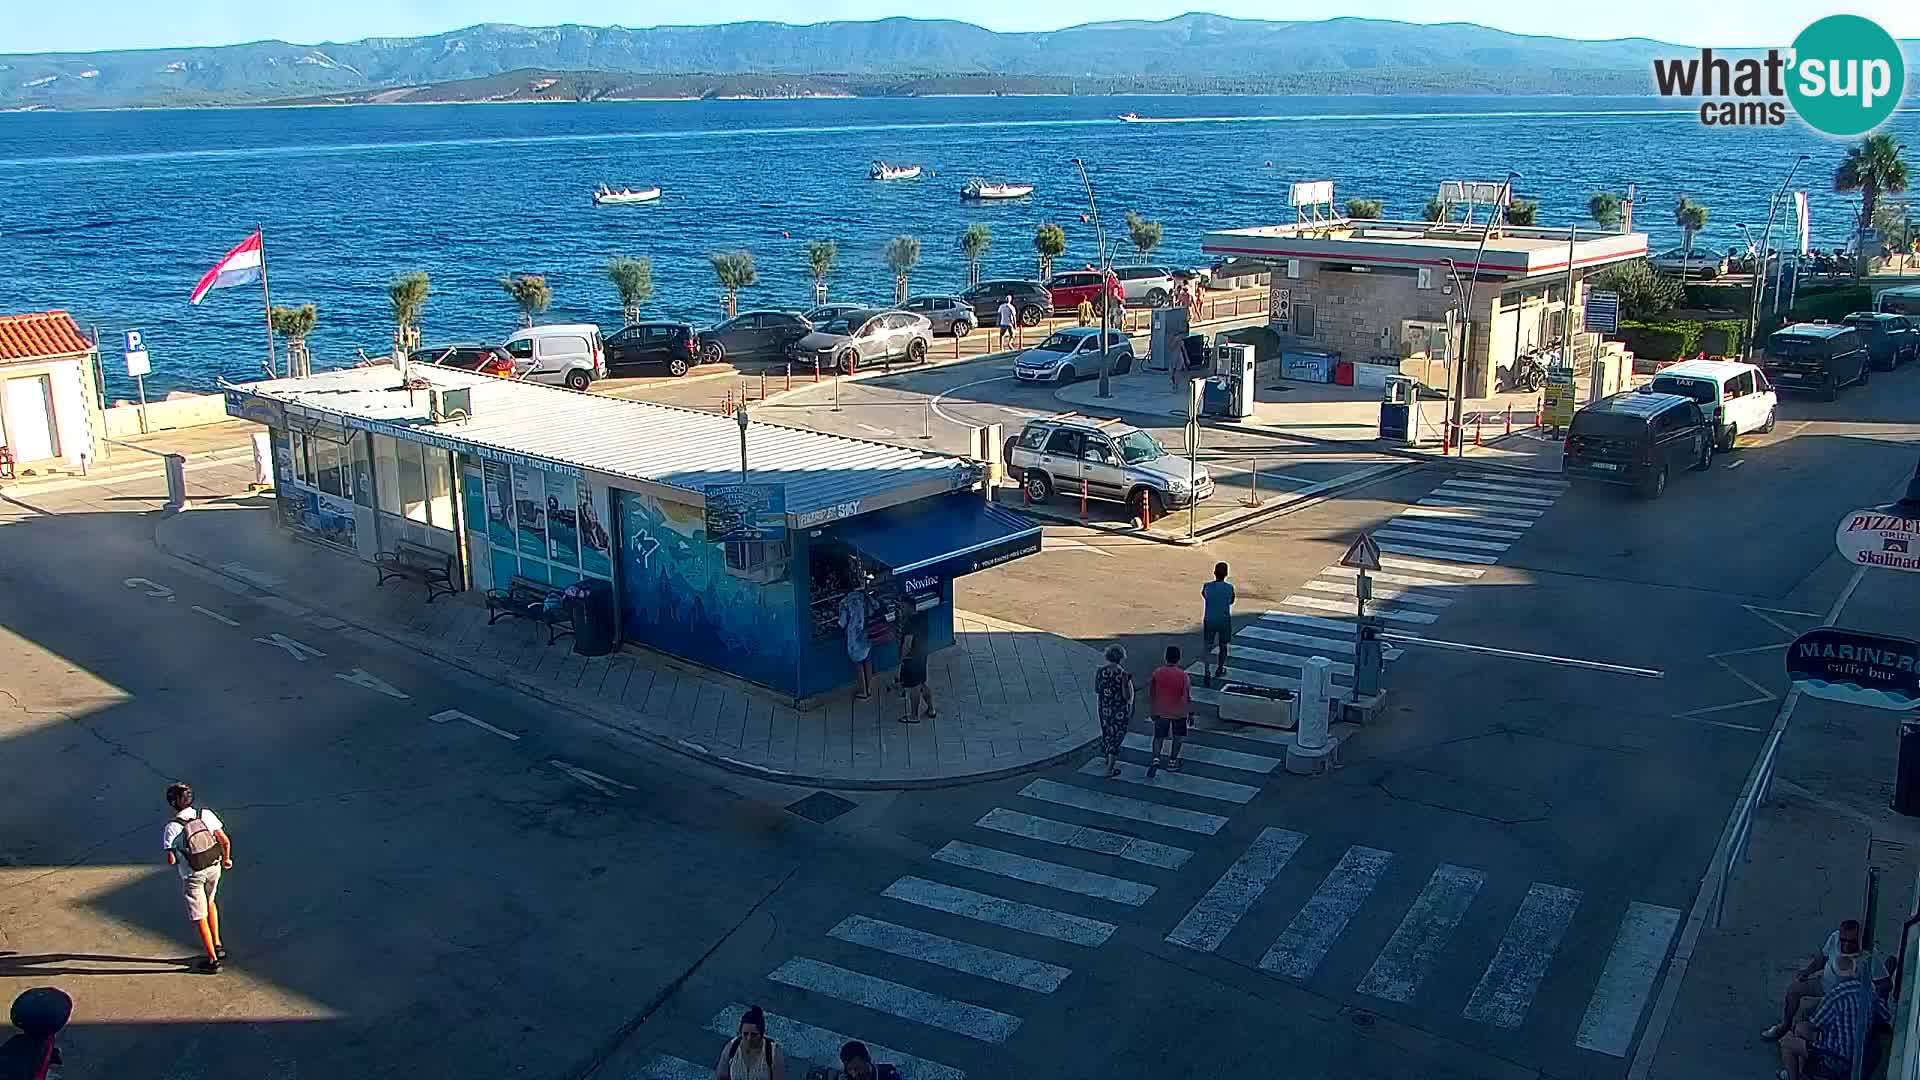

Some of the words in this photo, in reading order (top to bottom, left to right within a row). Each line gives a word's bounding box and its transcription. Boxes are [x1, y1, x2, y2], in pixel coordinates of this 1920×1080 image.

[128, 331, 142, 351] P
[1676, 378, 1694, 386] TAXI
[434, 438, 466, 453] POSTAJA
[477, 447, 491, 458] BUS
[492, 450, 524, 465] STATION
[528, 458, 553, 472] TICKET
[555, 464, 585, 480] OFFICE
[1869, 666, 1895, 680] bar
